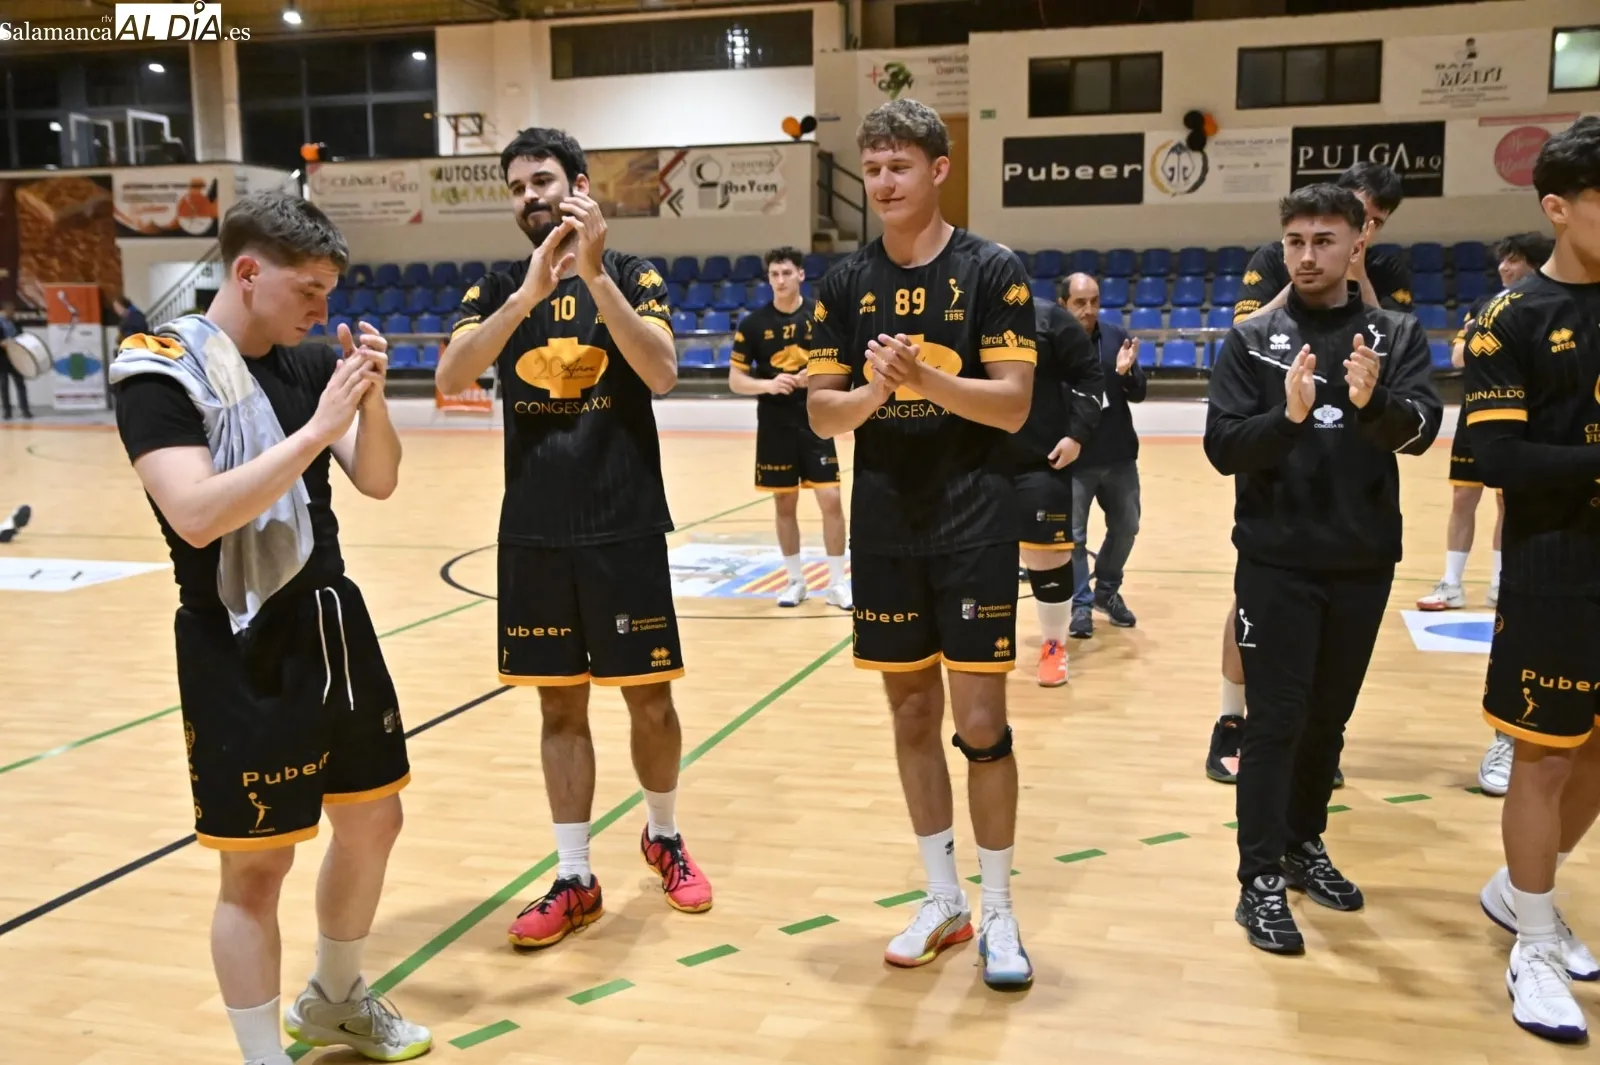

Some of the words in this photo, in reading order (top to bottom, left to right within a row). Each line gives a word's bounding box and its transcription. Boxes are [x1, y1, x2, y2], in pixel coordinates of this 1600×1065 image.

[1004, 162, 1142, 181] Pubeer
[551, 296, 576, 321] 10
[895, 287, 926, 315] 89
[783, 324, 796, 339] 27
[1551, 341, 1577, 353] errea
[515, 400, 590, 415] CONGESA
[870, 403, 937, 419] ONGESA
[506, 625, 572, 637] ubeer
[651, 659, 672, 667] errea
[1521, 669, 1600, 692] Pube
